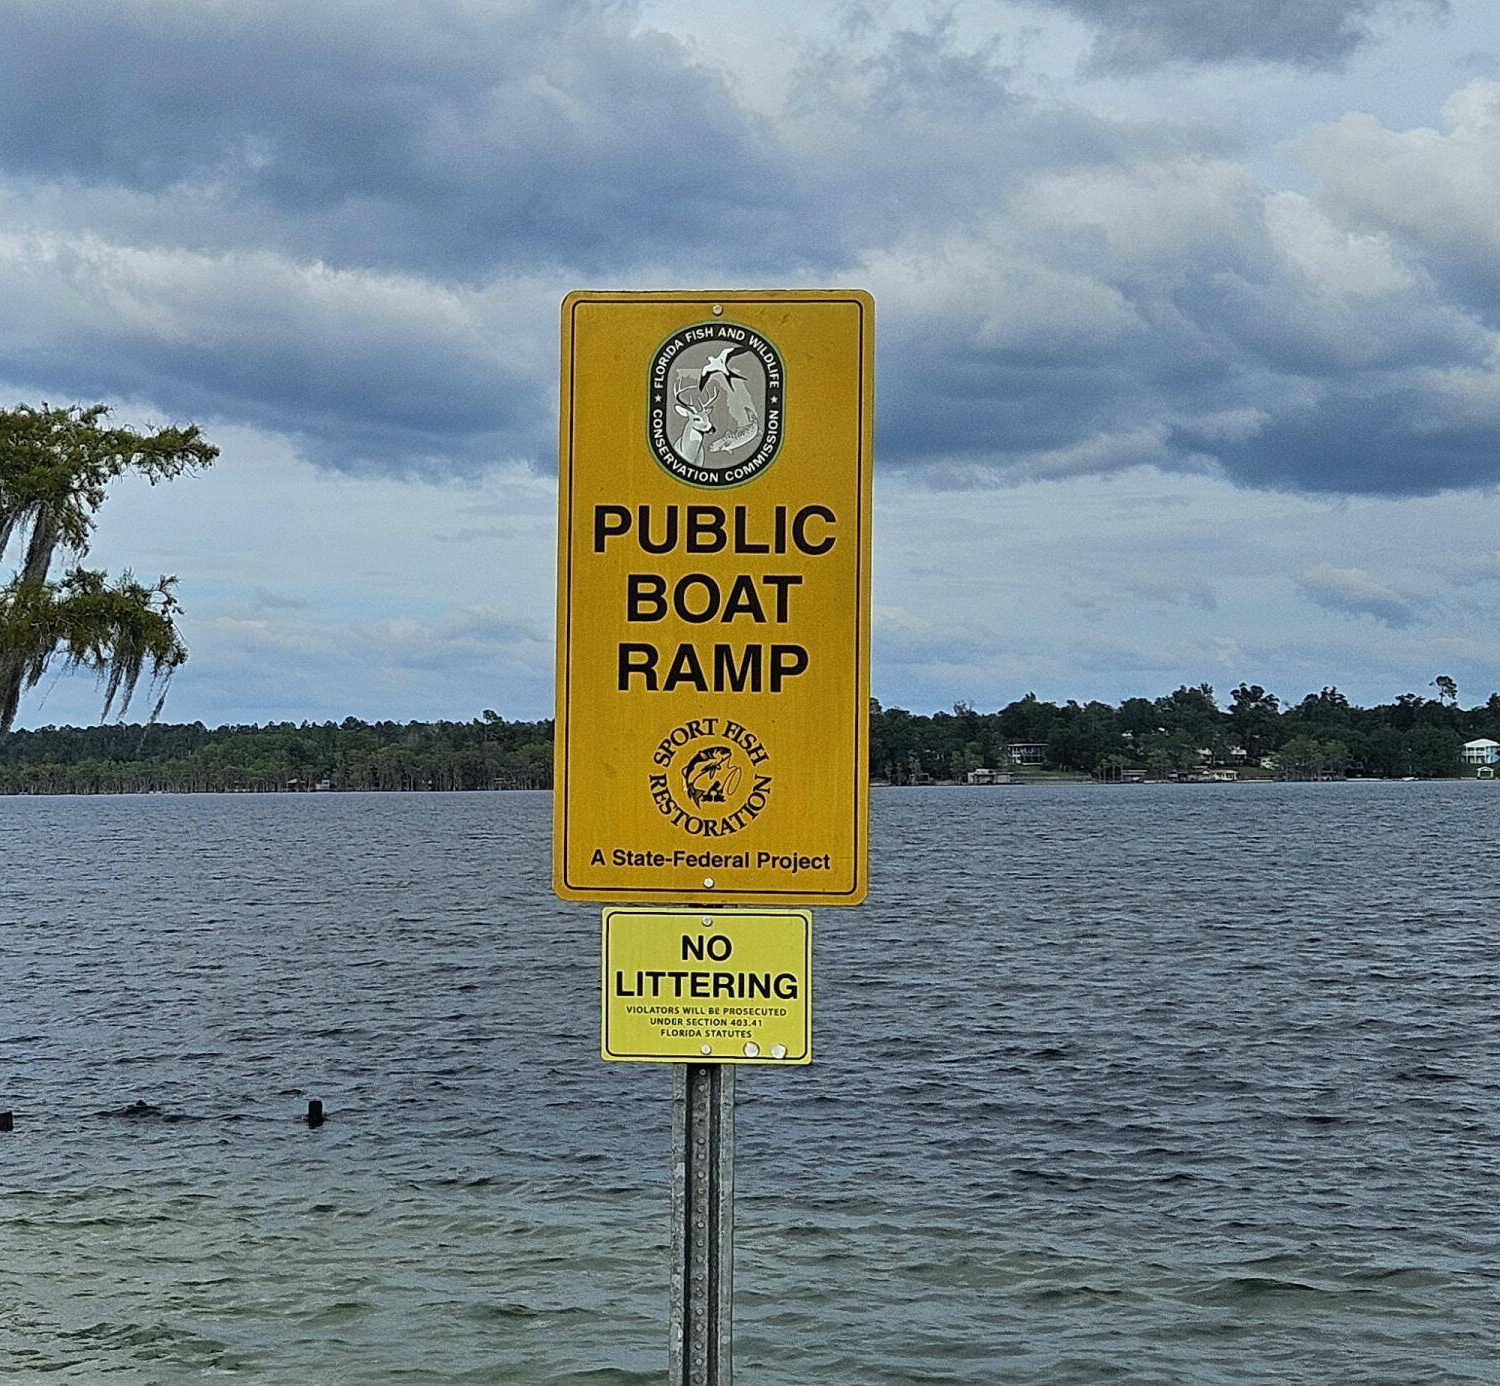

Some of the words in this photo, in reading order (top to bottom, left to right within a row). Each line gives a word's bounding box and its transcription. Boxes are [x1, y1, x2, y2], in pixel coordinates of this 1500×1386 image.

[654, 339, 684, 389] FLORIDA
[685, 326, 714, 343] FISH
[718, 327, 746, 341] AND
[748, 335, 780, 389] WILDLIFE
[652, 409, 719, 483] CONSERVATION
[724, 410, 780, 482] COMMISSION
[594, 505, 837, 556] PUBLIC
[627, 573, 803, 624] BOAT
[617, 642, 809, 692] RAMP
[653, 718, 718, 768] SPORT
[721, 720, 770, 766] FISH
[649, 773, 773, 837] RESTORATION
[590, 850, 606, 866] A
[612, 850, 750, 869] State-Federal
[757, 851, 831, 873] Project
[681, 935, 732, 961] NO
[616, 971, 798, 999] LITTERING
[626, 1006, 680, 1015] VIOLATORS
[682, 1006, 706, 1015] WILL
[708, 1007, 721, 1015] BE
[723, 1007, 787, 1017] PROSECUTED
[650, 1018, 683, 1026] UNDER
[686, 1018, 727, 1027] SECTION
[730, 1019, 762, 1027] 403.41
[660, 1029, 702, 1037] FLORIDA
[705, 1029, 752, 1038] STATUTES
